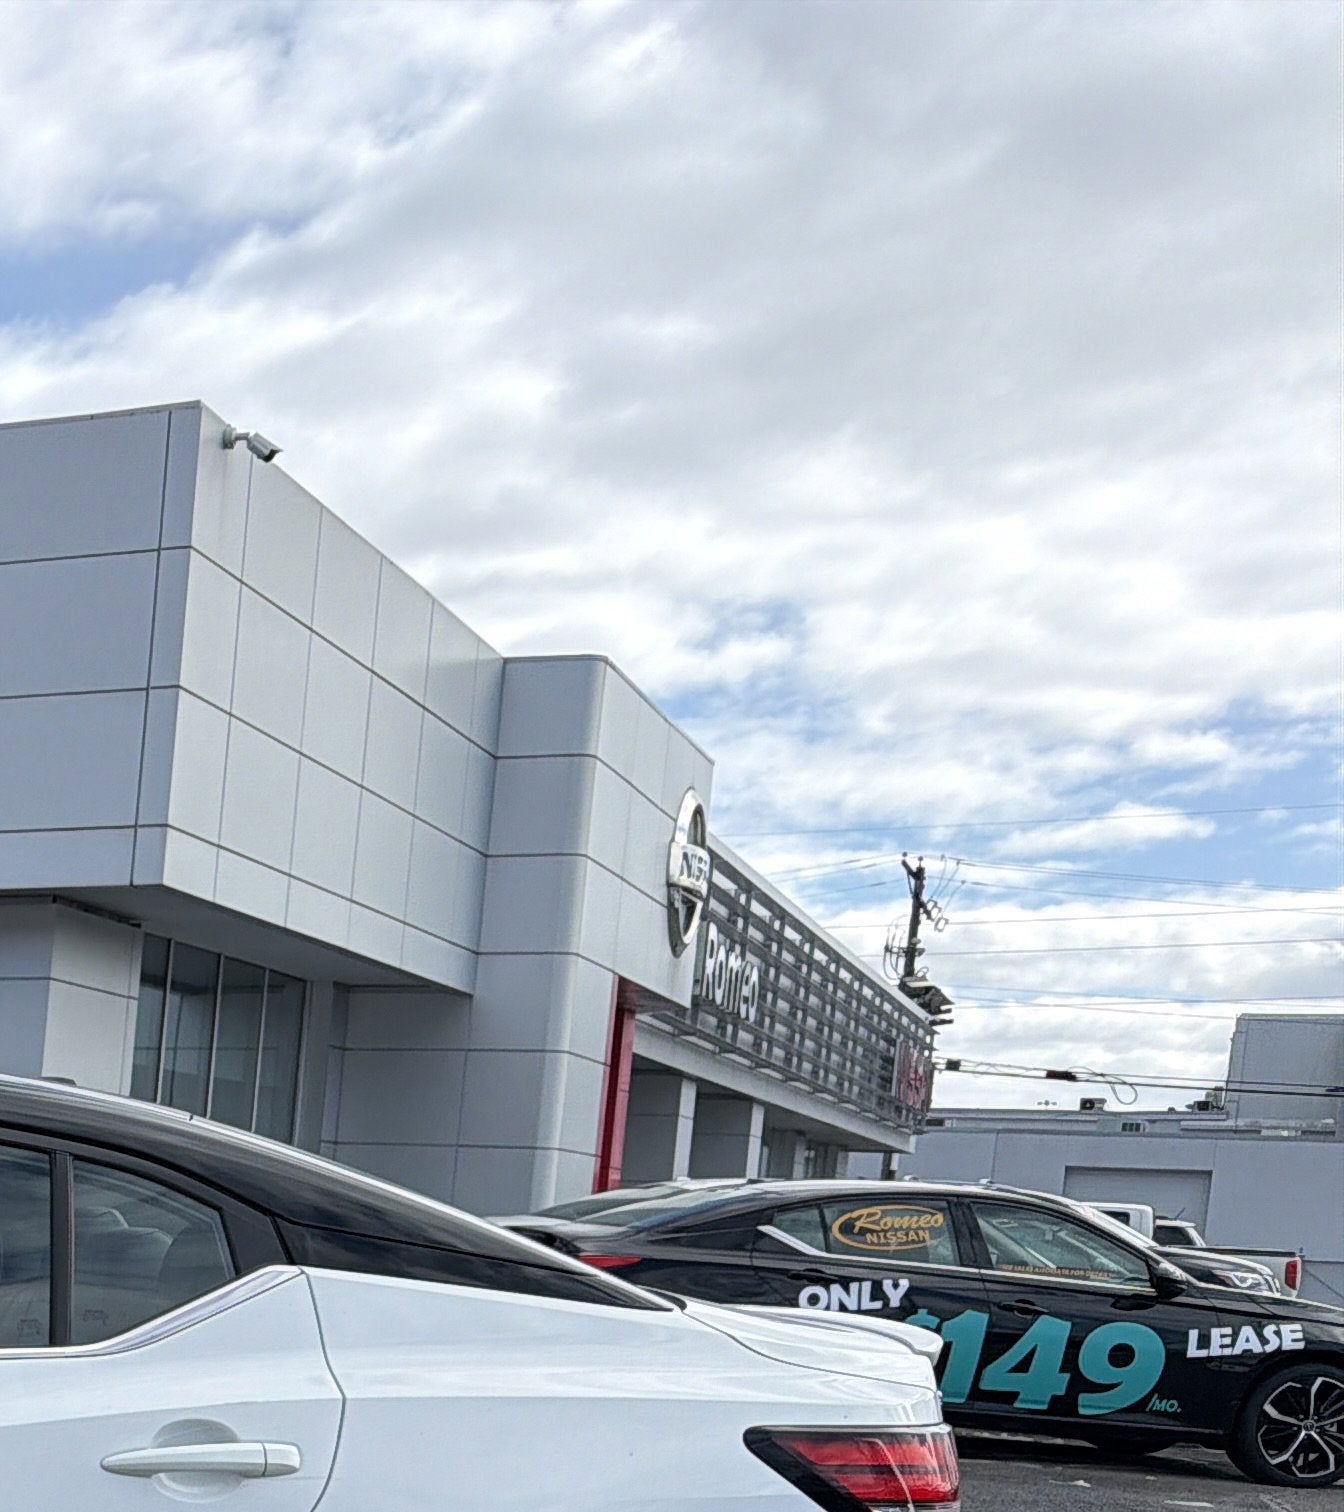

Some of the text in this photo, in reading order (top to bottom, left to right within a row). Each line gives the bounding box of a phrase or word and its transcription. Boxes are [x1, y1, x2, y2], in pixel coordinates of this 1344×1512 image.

[702, 921, 759, 1023] Romeo
[853, 1209, 944, 1234] Romeo
[866, 1230, 930, 1243] NISSAN
[798, 1279, 909, 1311] ONLY
[1186, 1323, 1306, 1358] LEASE
